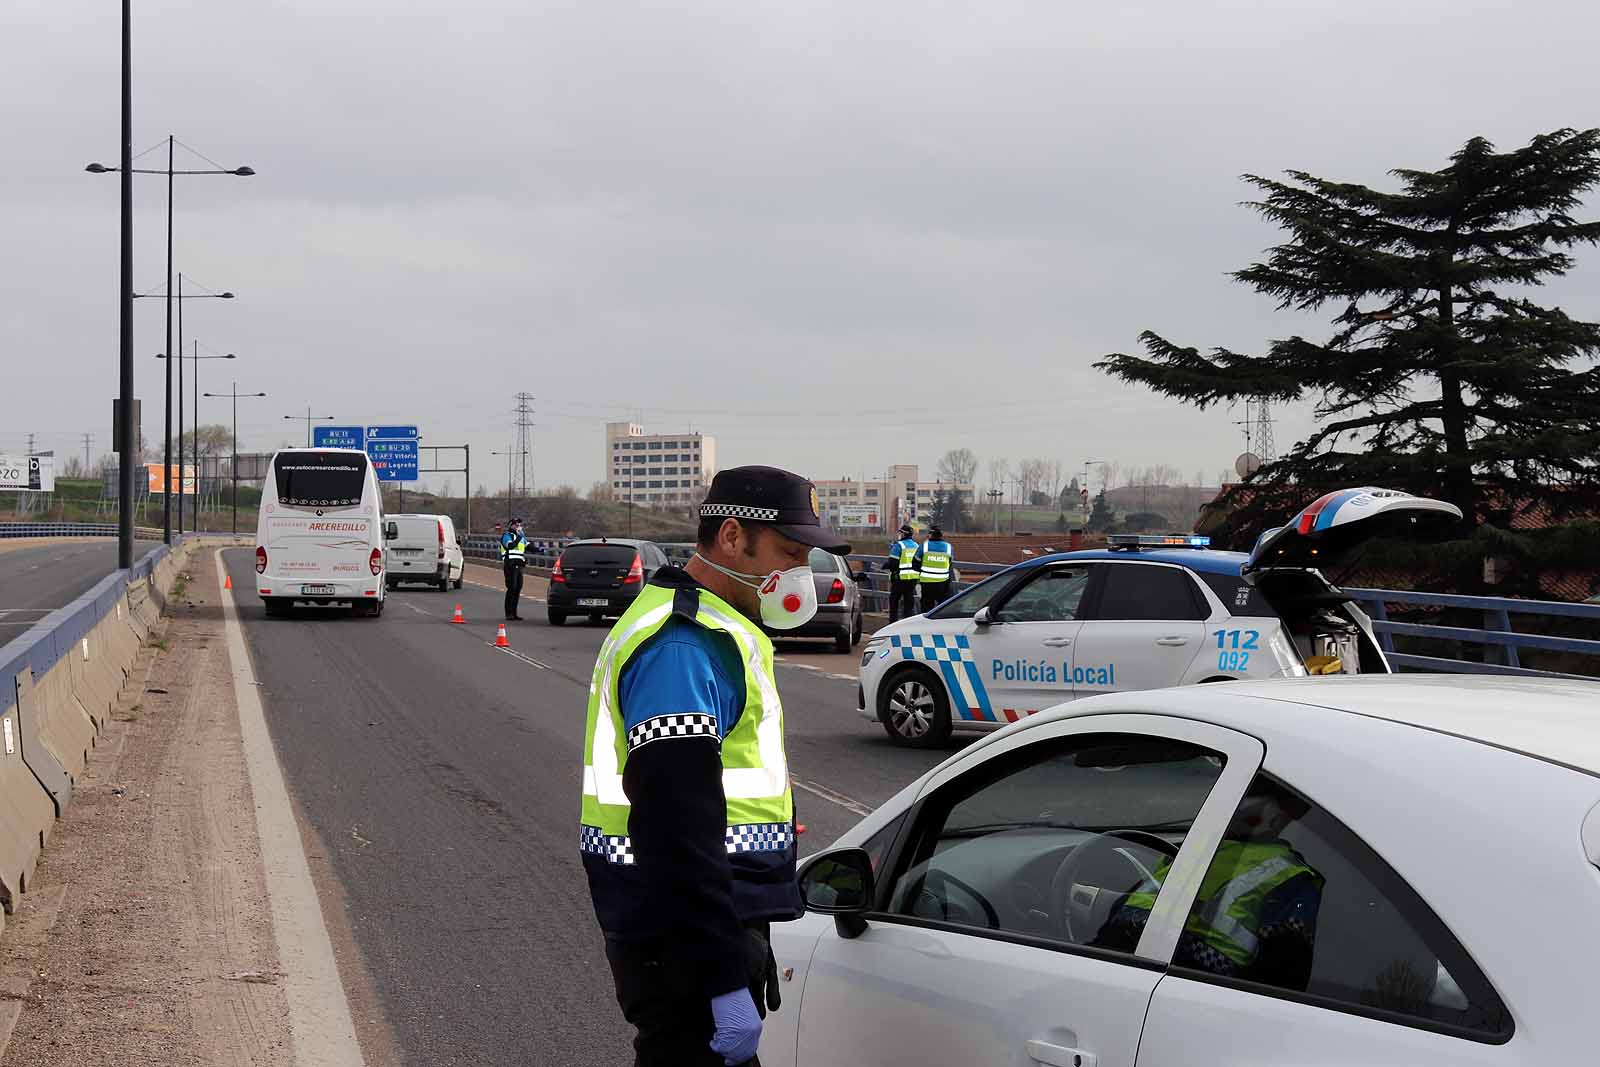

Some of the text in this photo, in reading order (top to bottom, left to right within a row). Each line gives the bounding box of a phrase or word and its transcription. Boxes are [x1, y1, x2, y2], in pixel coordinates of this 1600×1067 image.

[309, 522, 366, 531] ARCEREDILLO
[1213, 629, 1260, 649] 112
[1218, 651, 1249, 671] 092
[992, 659, 1114, 685] Policía Local
